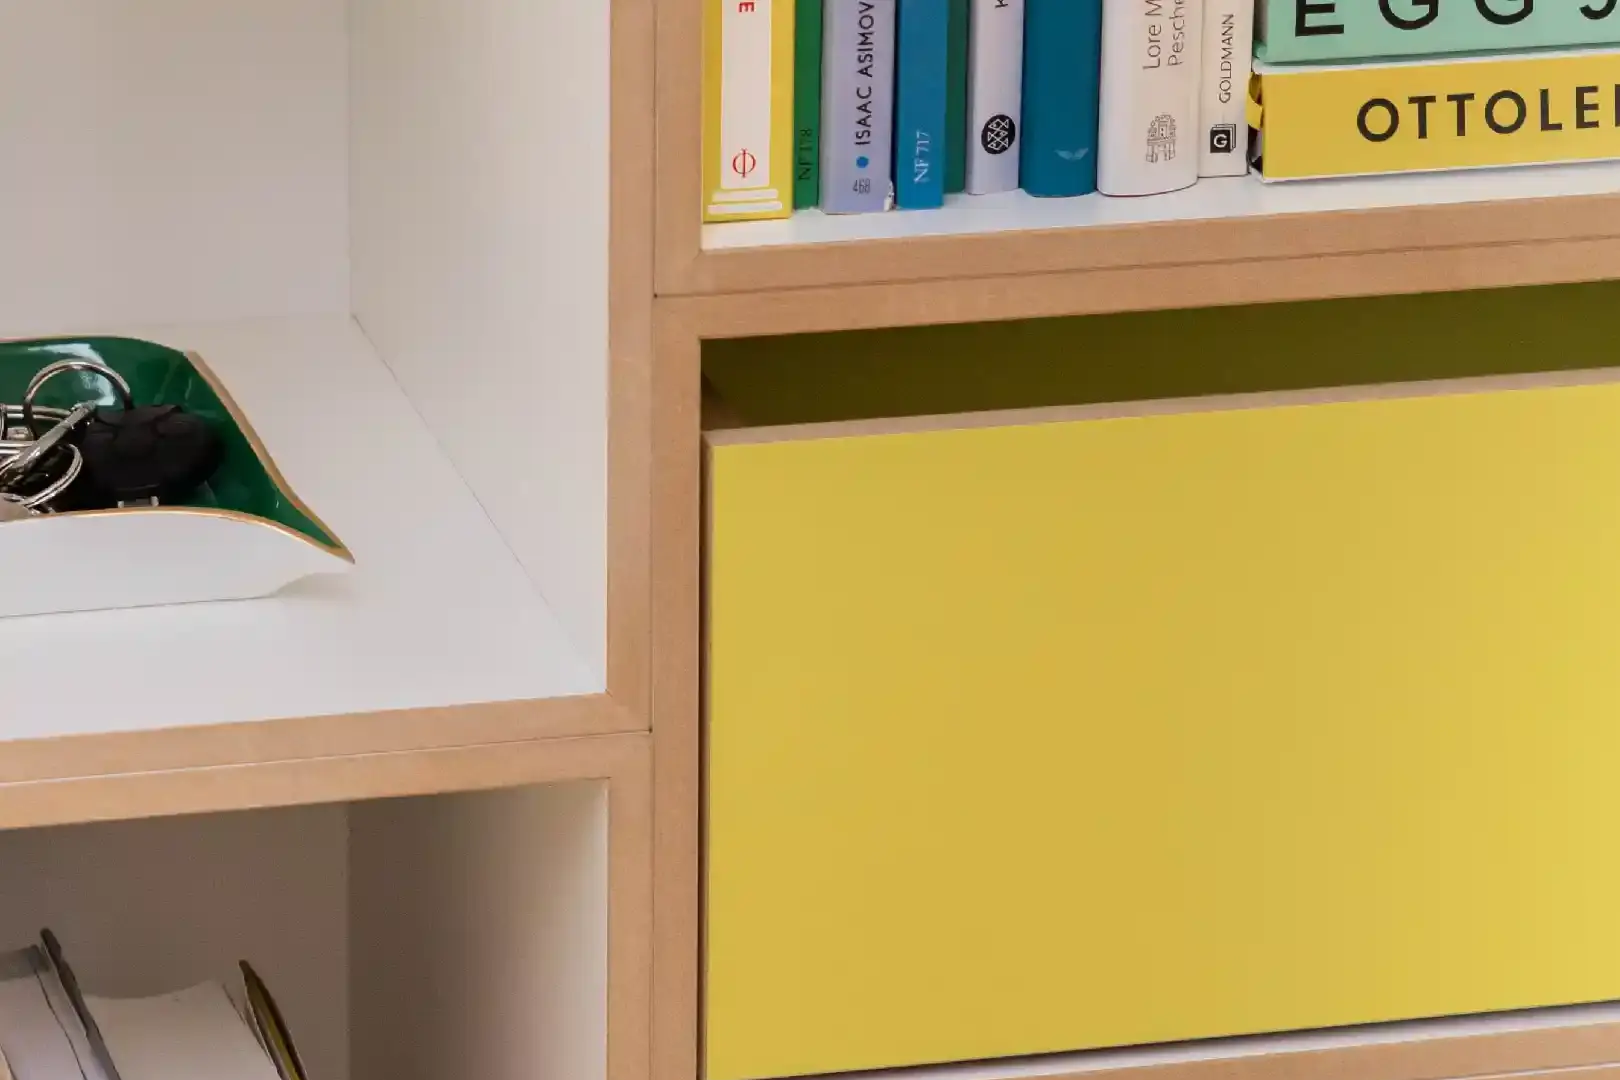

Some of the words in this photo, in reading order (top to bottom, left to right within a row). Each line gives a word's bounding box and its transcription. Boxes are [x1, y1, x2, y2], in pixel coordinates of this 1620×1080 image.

[857, 1, 875, 78] ASIMOV
[1142, 24, 1162, 70] Lore
[1218, 13, 1235, 104] GOLDMANN
[856, 86, 873, 146] ISAAC
[913, 159, 931, 184] NF
